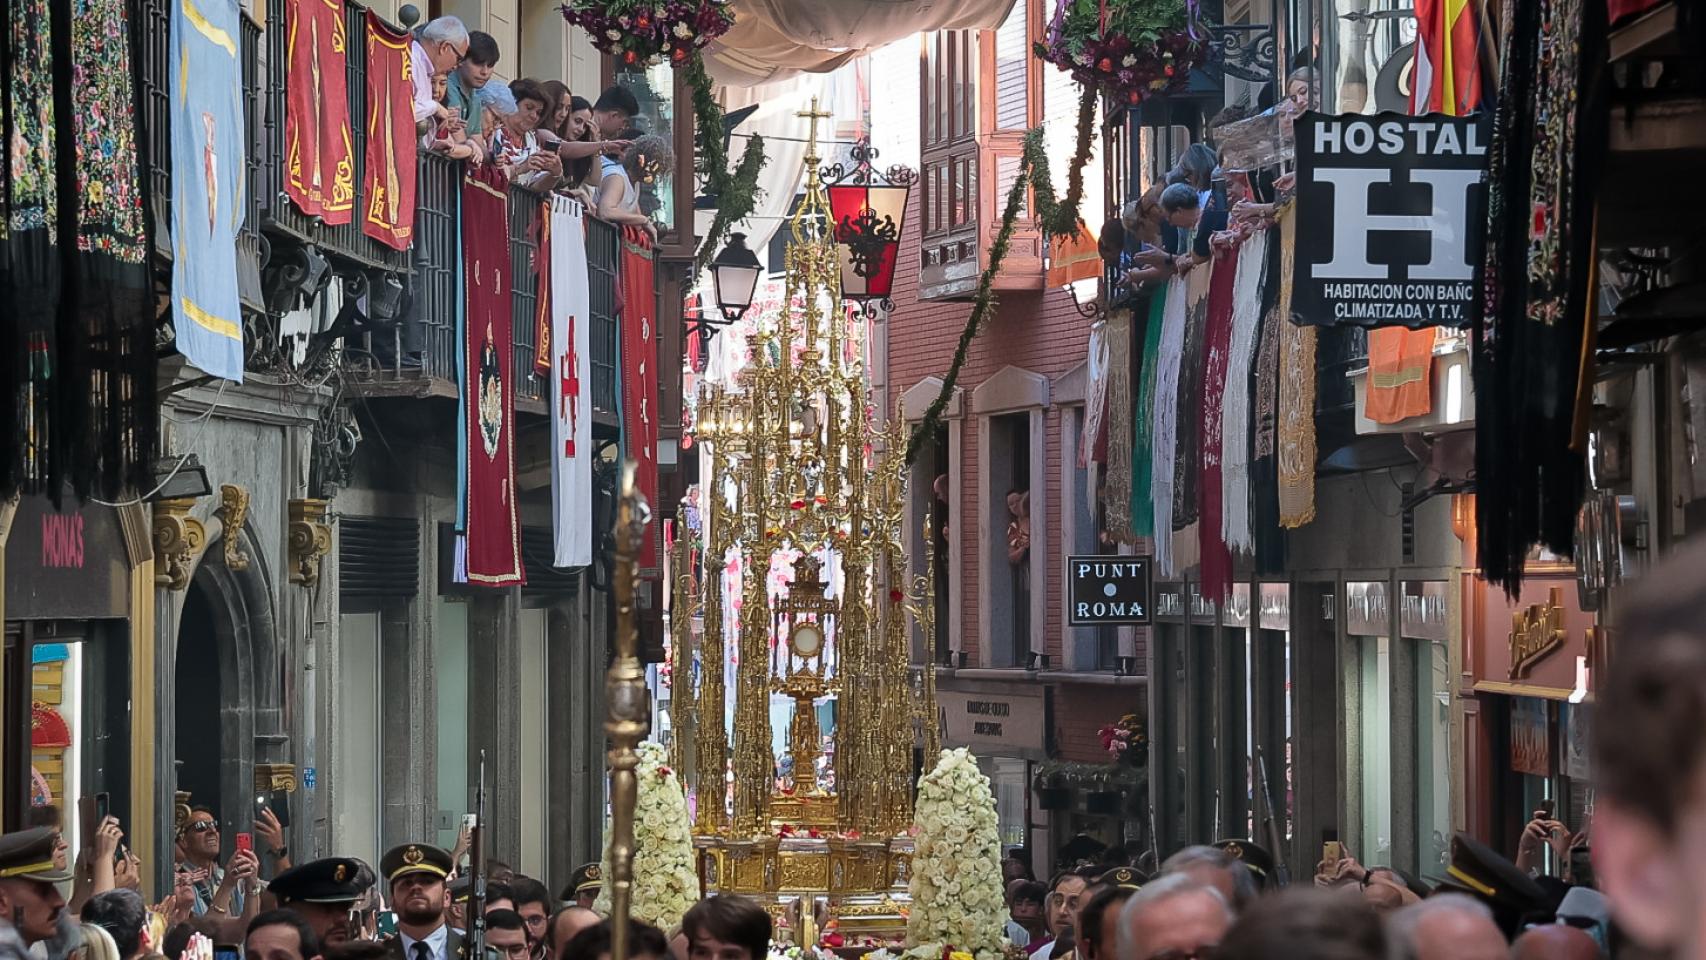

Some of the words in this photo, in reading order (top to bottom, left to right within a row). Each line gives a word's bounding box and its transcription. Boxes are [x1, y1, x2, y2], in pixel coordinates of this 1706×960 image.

[1314, 121, 1487, 155] HOSTAL
[1312, 168, 1484, 280] H
[1324, 283, 1405, 300] HABITACION
[1405, 285, 1436, 300] CON
[1334, 302, 1422, 319] CLIMATIZADA
[1427, 304, 1438, 319] Y
[1439, 304, 1464, 319] T.V.
[1078, 564, 1141, 578] PUNT
[1077, 602, 1143, 617] ROMA
